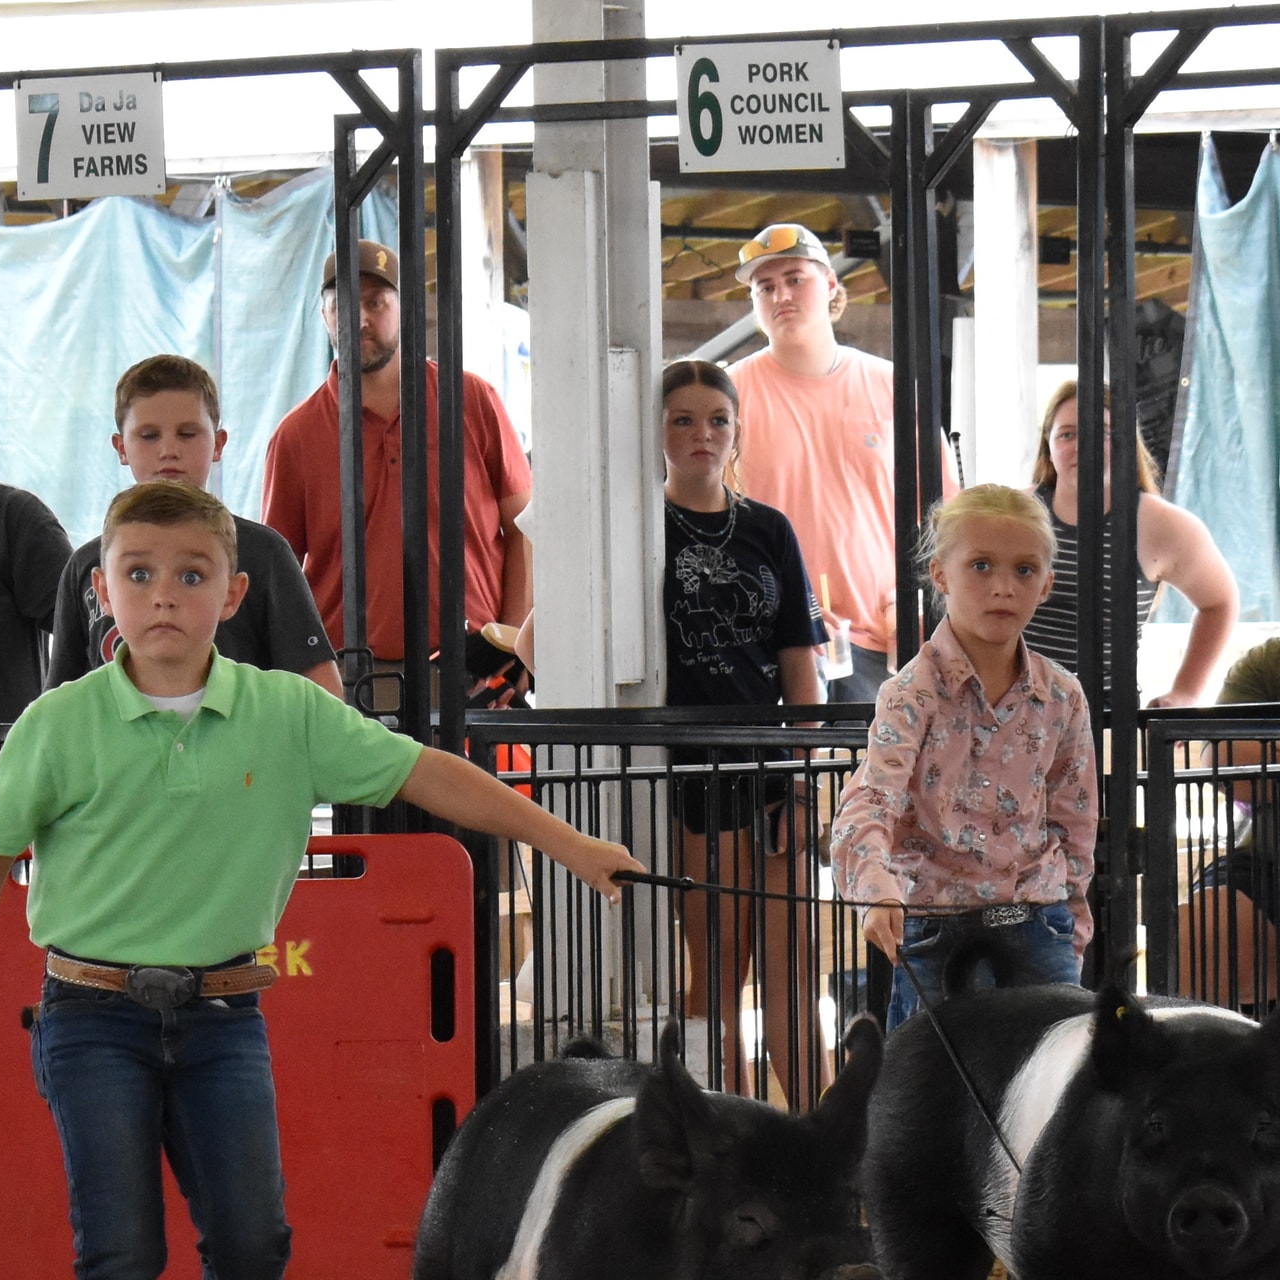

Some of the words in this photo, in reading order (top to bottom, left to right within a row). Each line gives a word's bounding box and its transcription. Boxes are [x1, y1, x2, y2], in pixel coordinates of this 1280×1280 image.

[748, 62, 809, 83] PORK
[78, 91, 106, 113] Da
[113, 90, 137, 111] Ja
[688, 57, 723, 157] 6
[730, 92, 830, 115] COUNCIL
[28, 93, 60, 184] 7
[81, 122, 136, 145] VIEW
[738, 123, 824, 145] WOMEN
[73, 153, 148, 178] FARMS
